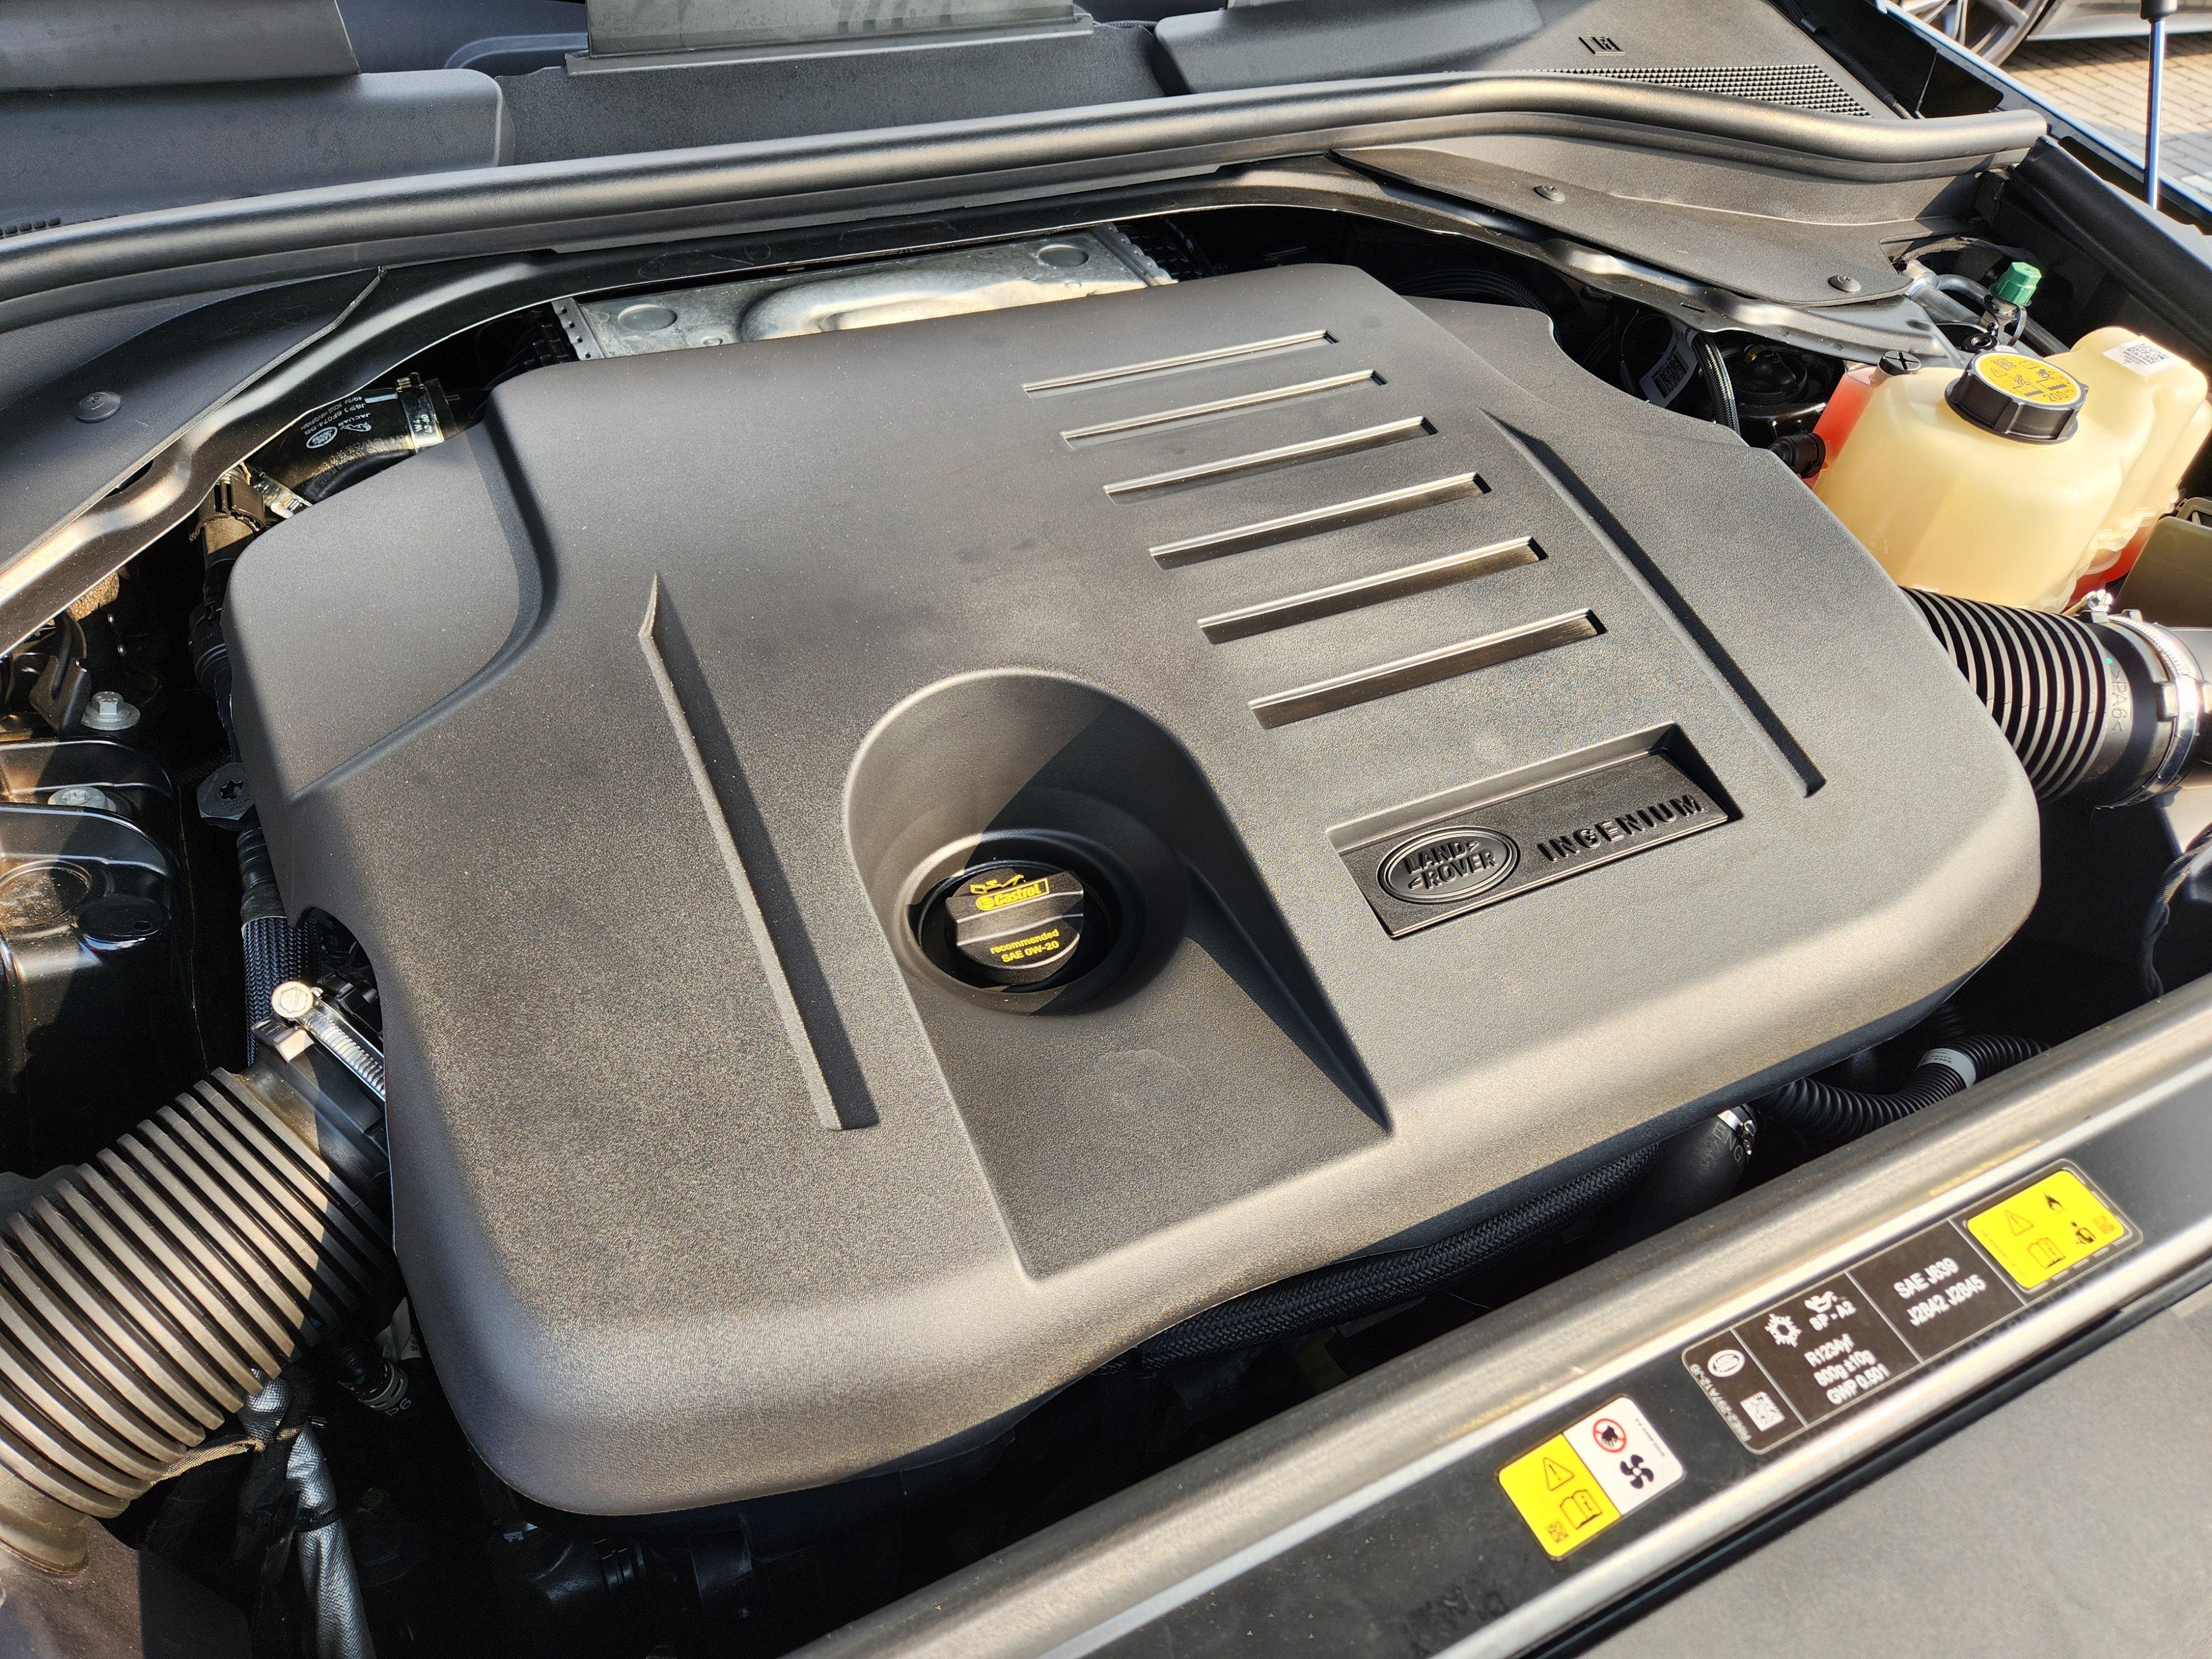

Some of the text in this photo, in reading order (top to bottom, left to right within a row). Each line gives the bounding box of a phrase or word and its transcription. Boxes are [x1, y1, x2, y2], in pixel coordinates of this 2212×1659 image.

[2043, 391, 2069, 402] 200
[1536, 794, 1705, 863] INGENIUM
[1403, 840, 1472, 875] LAND
[1421, 850, 1500, 890] ROVER
[994, 883, 1041, 906] Castrol
[989, 929, 1060, 955] recommended
[1001, 941, 1060, 963] SAE 0W-20
[1712, 1121, 1743, 1162] ENG
[1893, 1257, 1960, 1299] SAE J639
[1907, 1274, 1987, 1327] J2842 J2845
[1803, 1333, 1855, 1368] R1234yf
[1825, 1363, 1891, 1405] GWP 0.501
